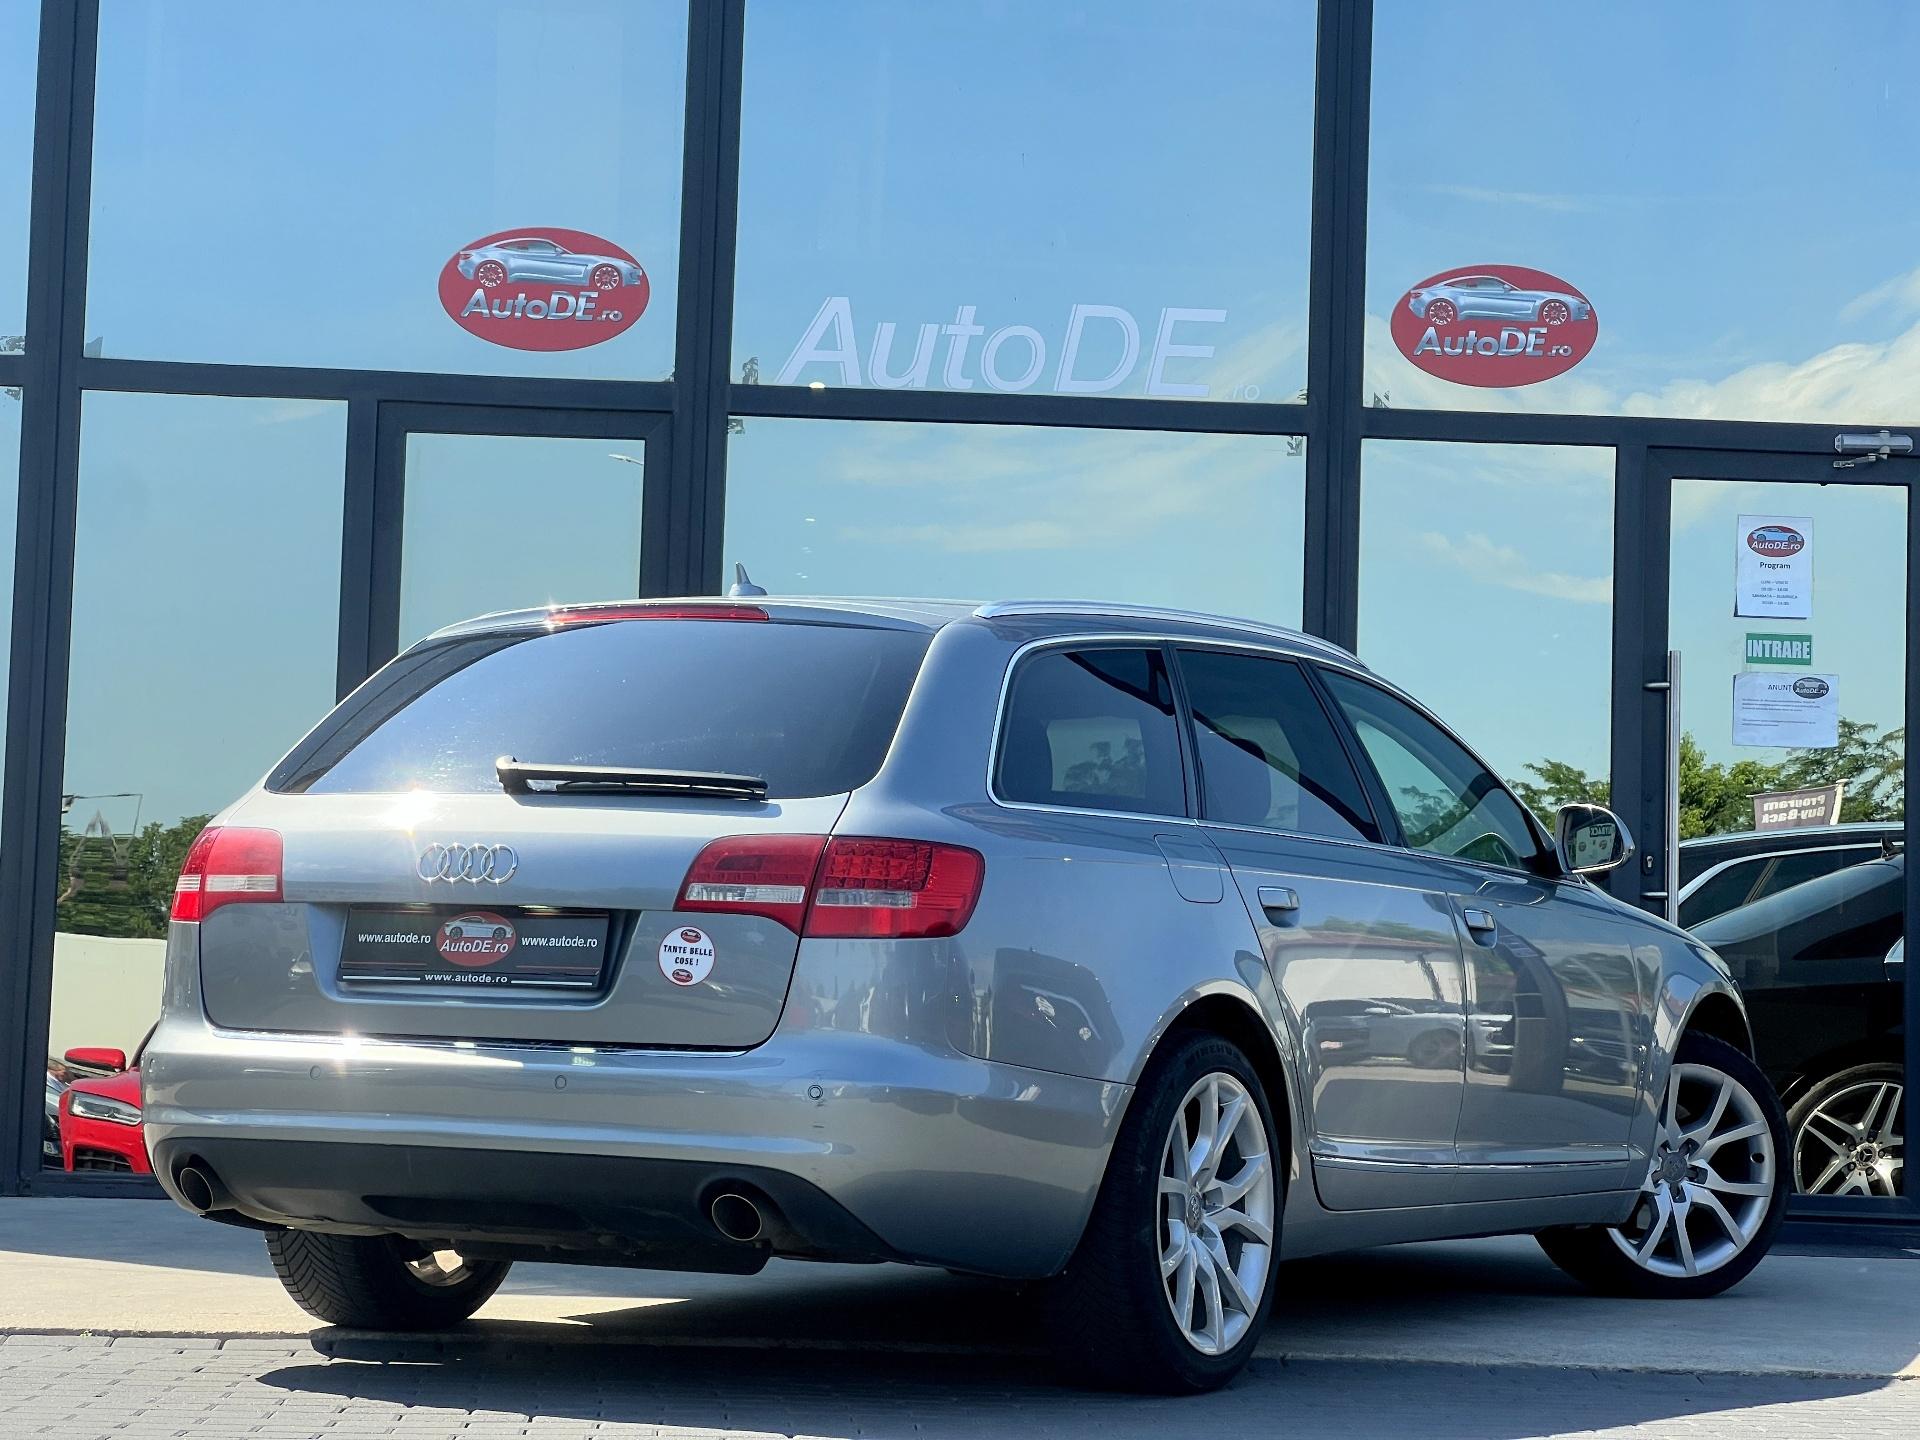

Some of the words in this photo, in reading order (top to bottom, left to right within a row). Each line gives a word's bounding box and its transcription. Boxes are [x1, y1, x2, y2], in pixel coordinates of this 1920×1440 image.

[1759, 561, 1791, 570] Program
[1747, 639, 1811, 658] INTRARE
[358, 932, 431, 944] www.autode.ro
[521, 935, 598, 948] www.autode.ro
[439, 939, 509, 953] AutoDE.ro
[663, 944, 687, 954] TANTE
[689, 947, 713, 957] BELLE
[674, 956, 694, 966] COSE
[424, 972, 508, 984] www.autode.ro
